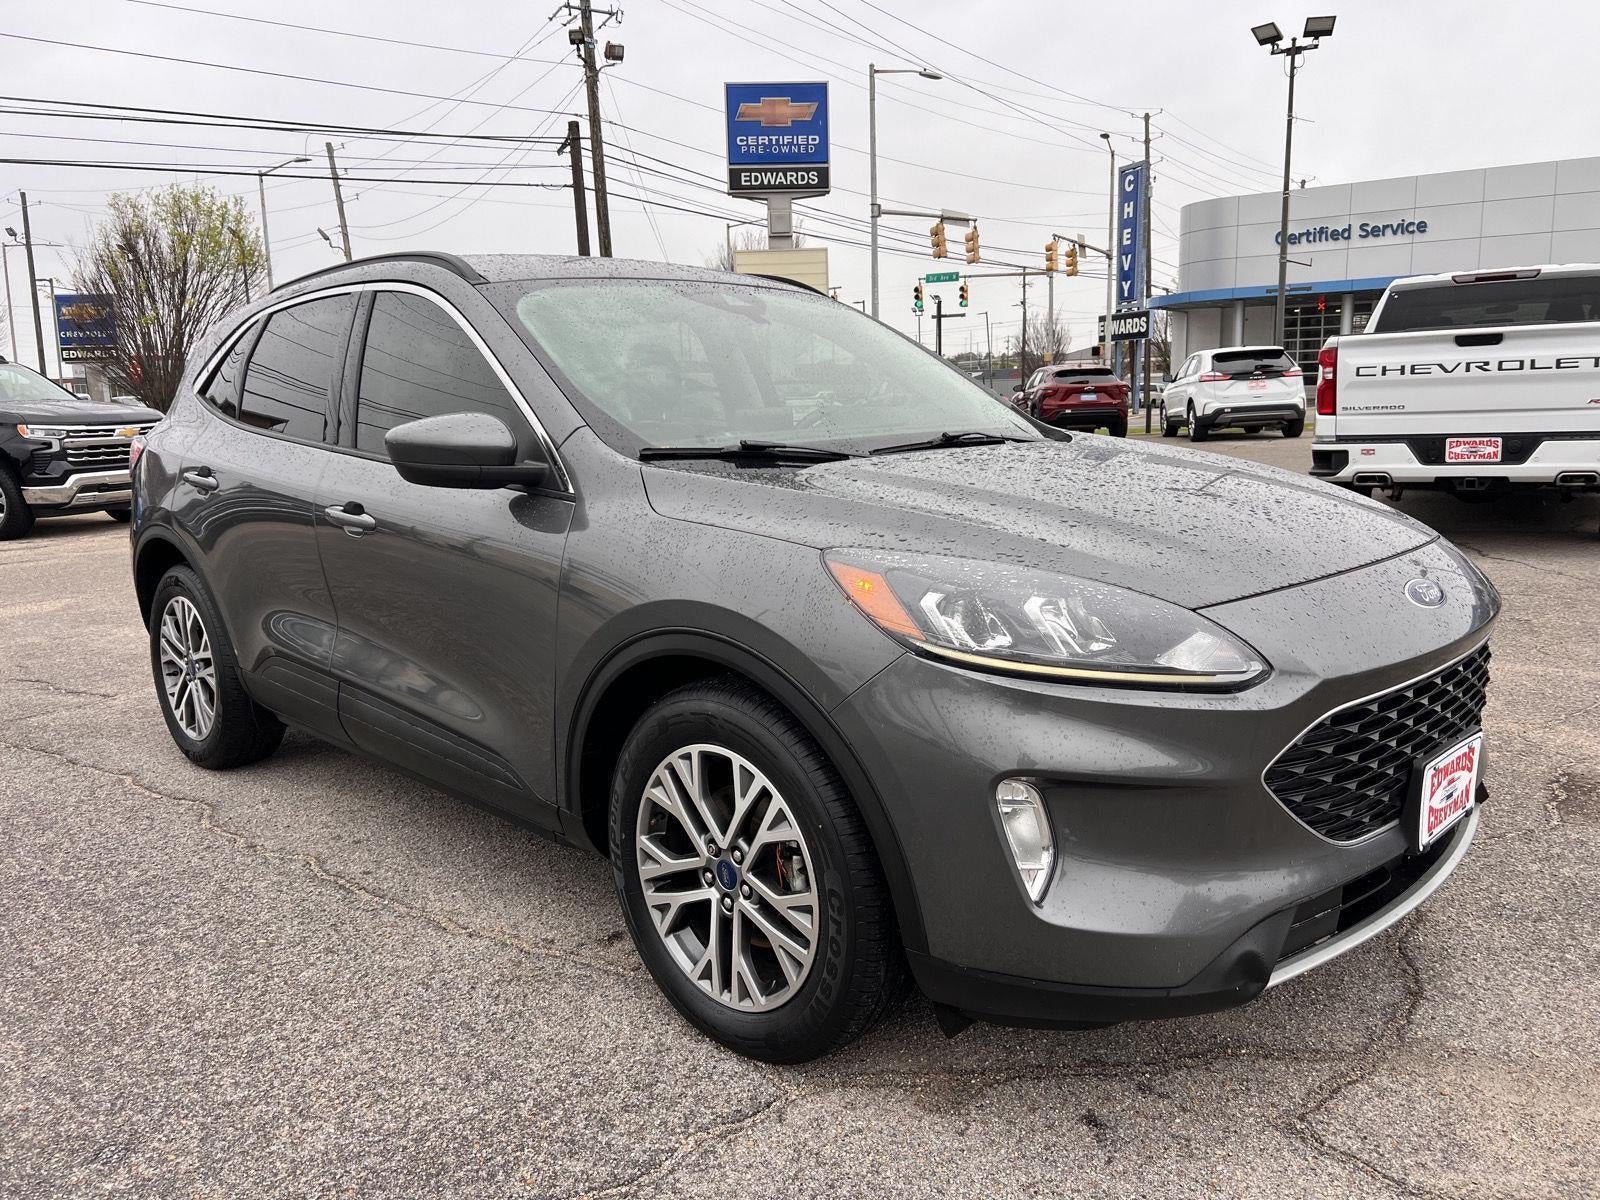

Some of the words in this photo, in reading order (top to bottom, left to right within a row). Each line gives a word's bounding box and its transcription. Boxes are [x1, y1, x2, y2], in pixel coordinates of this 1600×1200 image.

[736, 135, 819, 145] CERTIFIED
[741, 145, 816, 154] PRE-OWNED
[740, 171, 819, 186] EDWARDS
[1121, 175, 1134, 297] CHEVY
[1358, 219, 1428, 239] Service
[1098, 316, 1147, 336] EWARDS
[1355, 357, 1600, 377] CHEVROLET
[1448, 439, 1499, 450] EDWARDS
[1448, 450, 1499, 461] CHEVYMAN
[1429, 747, 1475, 802] EDWARDS
[1427, 778, 1472, 834] CHEVYMAN
